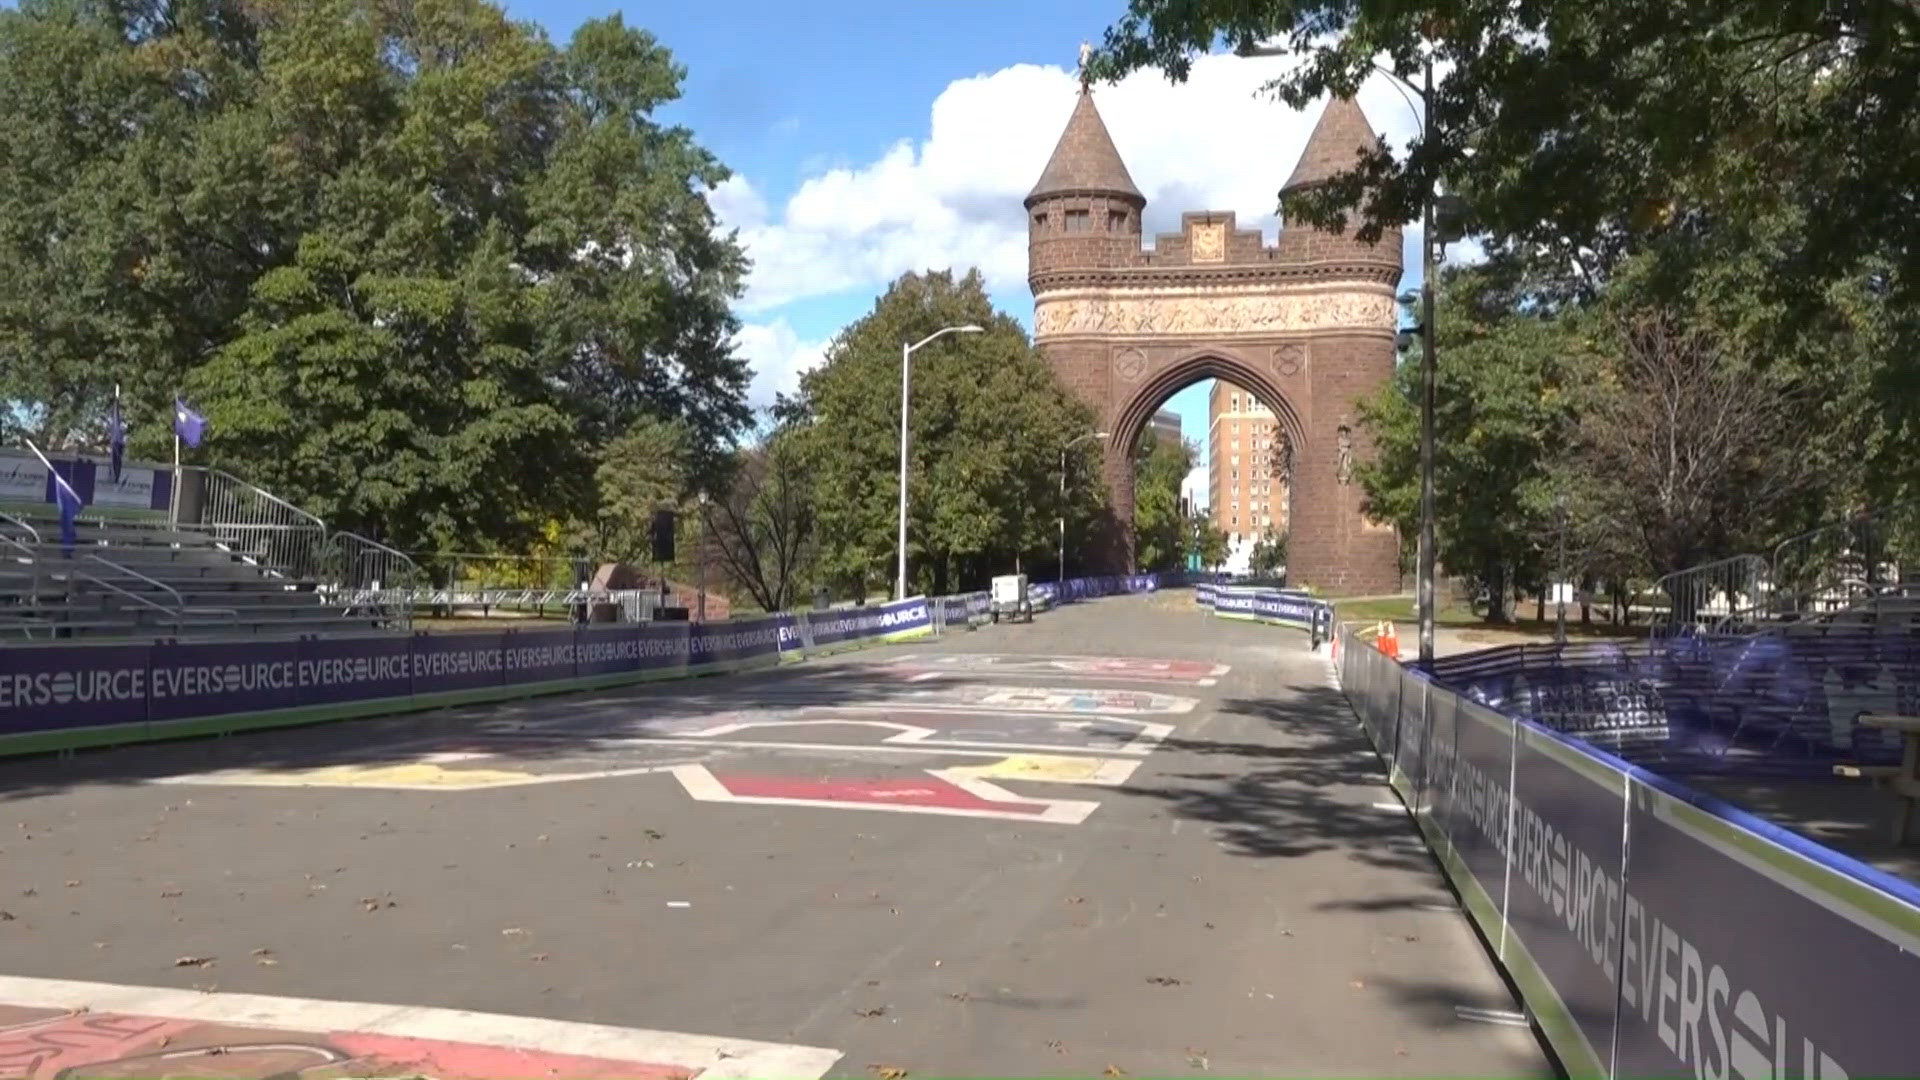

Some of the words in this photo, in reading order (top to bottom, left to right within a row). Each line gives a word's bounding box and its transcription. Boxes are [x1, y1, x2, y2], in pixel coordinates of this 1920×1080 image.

[414, 649, 503, 677] EVERSOURCE
[506, 644, 576, 669] EVERSOURCE
[577, 641, 637, 664] EVERSOURCE
[153, 662, 293, 697] EVERSOURCE
[298, 654, 410, 686] EVERSOURCE
[1508, 797, 1618, 985] EVERSOURCE
